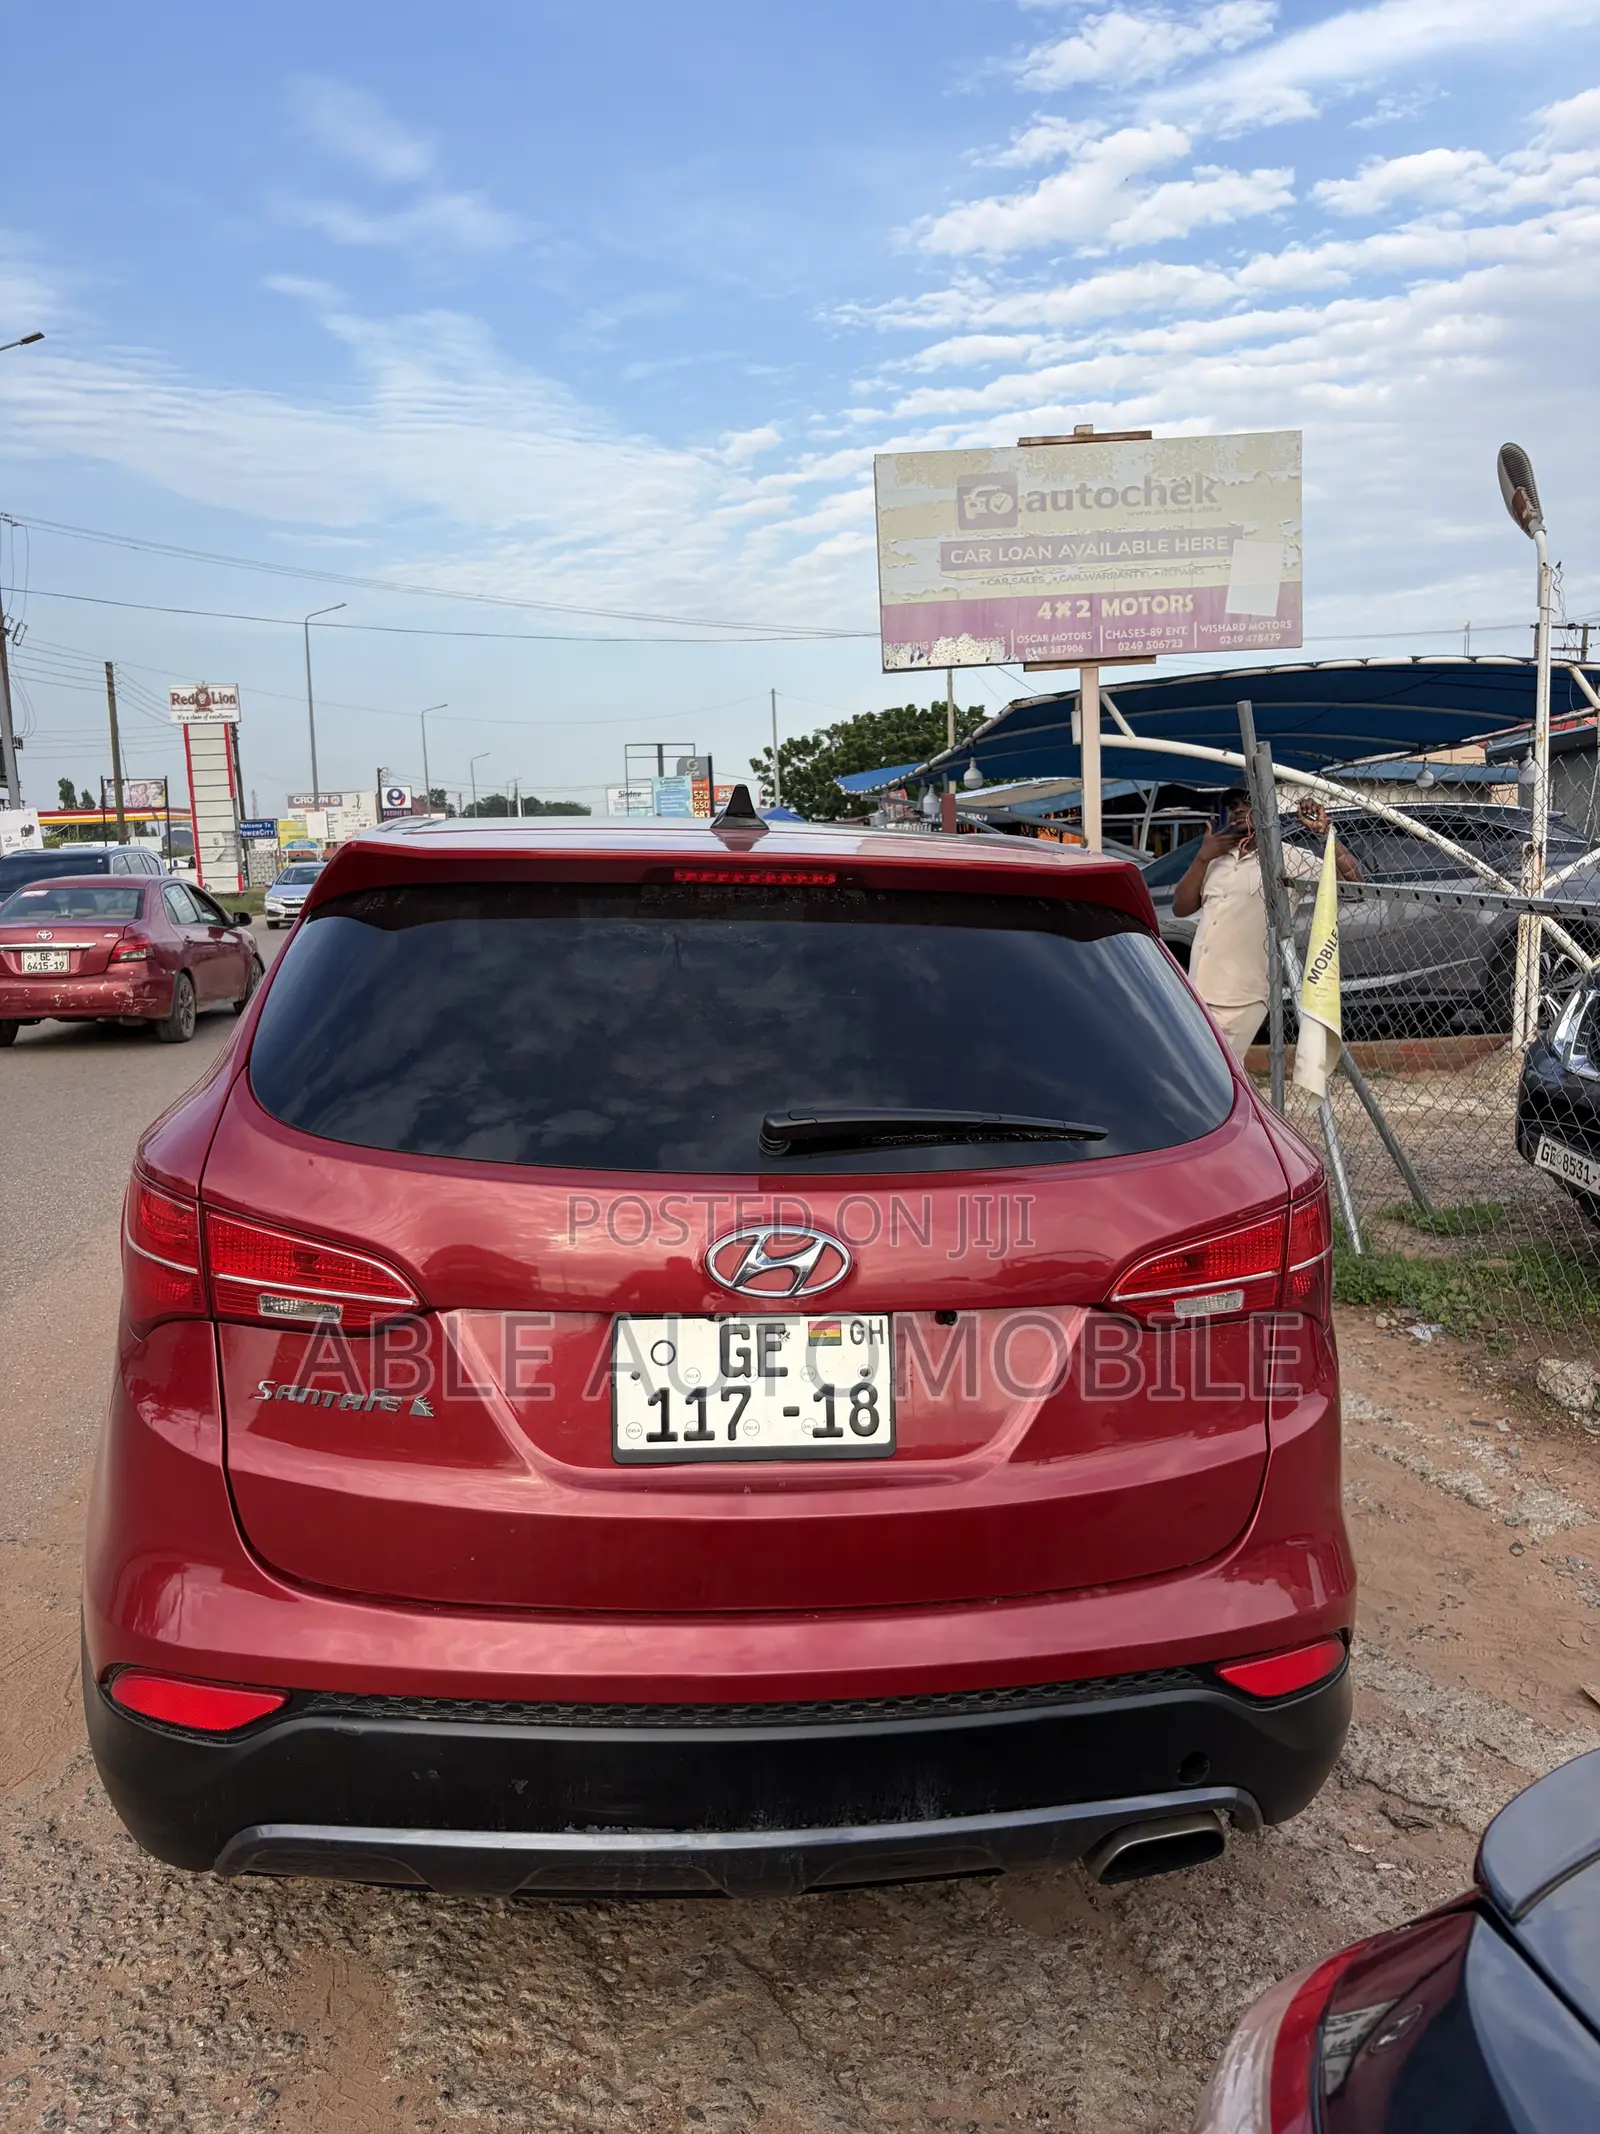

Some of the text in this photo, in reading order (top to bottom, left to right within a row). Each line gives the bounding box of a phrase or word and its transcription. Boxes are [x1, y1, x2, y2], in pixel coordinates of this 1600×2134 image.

[1025, 472, 1219, 513] autochek
[950, 536, 1229, 564] CAR LOAN AVAILABLE HERE
[1101, 594, 1194, 619] MOTORS
[1105, 627, 1163, 640] CHASES-89
[1200, 620, 1292, 633] WISHARD MOTORS
[1016, 631, 1093, 645] OSCAR MOTORS
[1220, 634, 1244, 645] 0249
[1118, 639, 1183, 652] 0249 506723
[170, 690, 237, 705] Red Lion
[1306, 929, 1339, 985] MOBILE
[27, 961, 65, 971] 6415-19
[720, 1318, 885, 1379] GE GH
